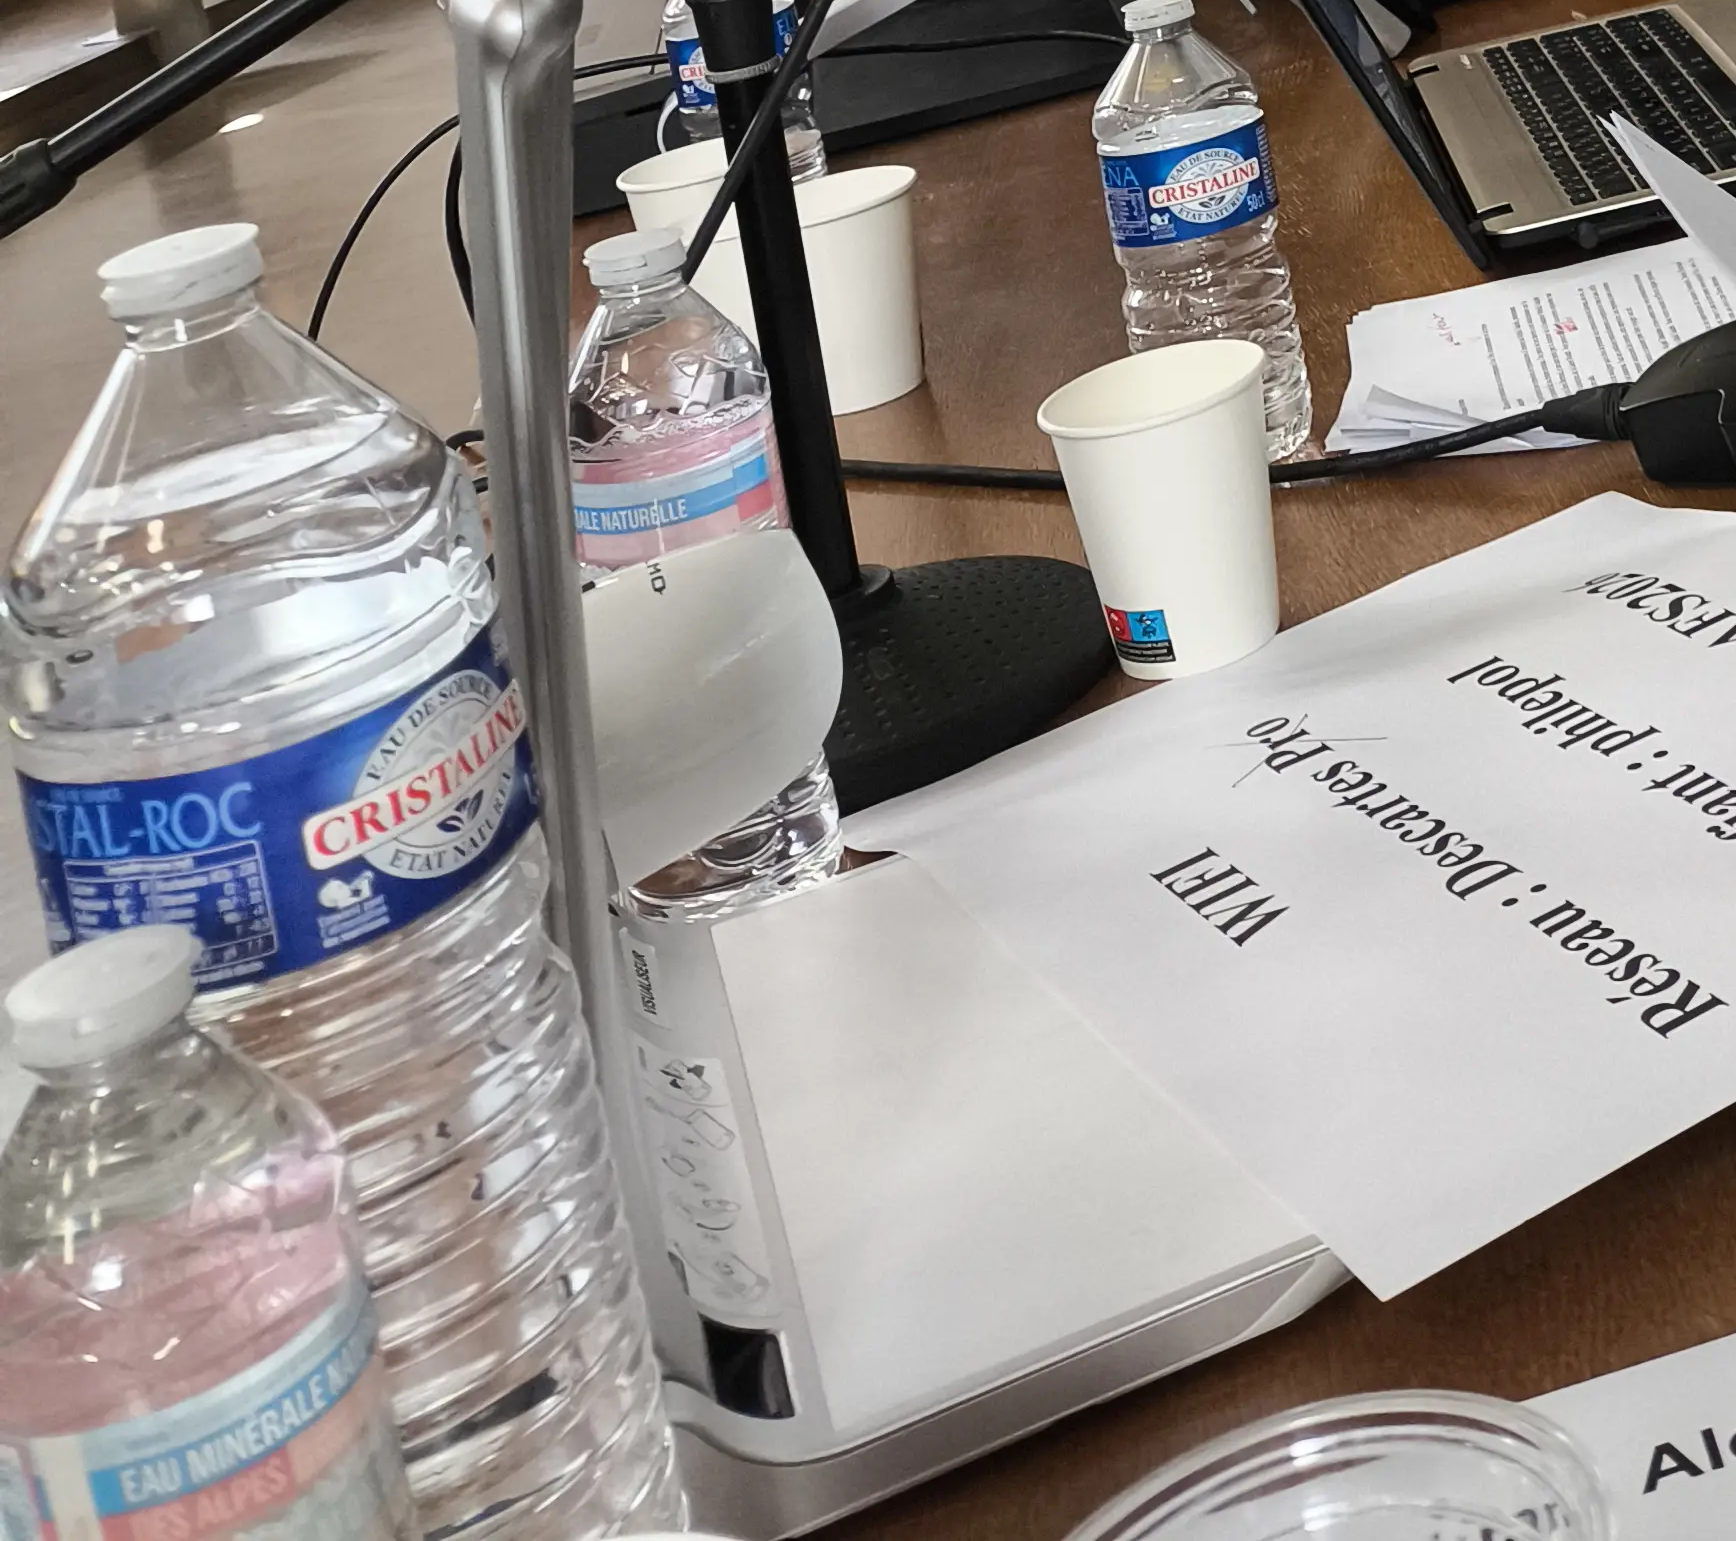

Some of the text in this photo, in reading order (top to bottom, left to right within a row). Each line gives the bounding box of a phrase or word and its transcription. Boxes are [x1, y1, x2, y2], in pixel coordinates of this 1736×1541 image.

[1151, 160, 1258, 205] CRISTALINE
[1189, 153, 1202, 166] DE
[1177, 207, 1203, 221] ETAT
[601, 498, 688, 532] NATURELLE
[366, 725, 407, 782] EAU
[407, 696, 439, 729] DE
[1446, 655, 1662, 758] philepol
[312, 694, 521, 857] CRISTALINE
[1246, 717, 1335, 775] Pro
[1310, 760, 1524, 902] Descartes
[1149, 846, 1290, 948] WIFI
[1529, 899, 1730, 1040] Réseau
[119, 1456, 182, 1504] EAU
[198, 1456, 289, 1530] ALPES
